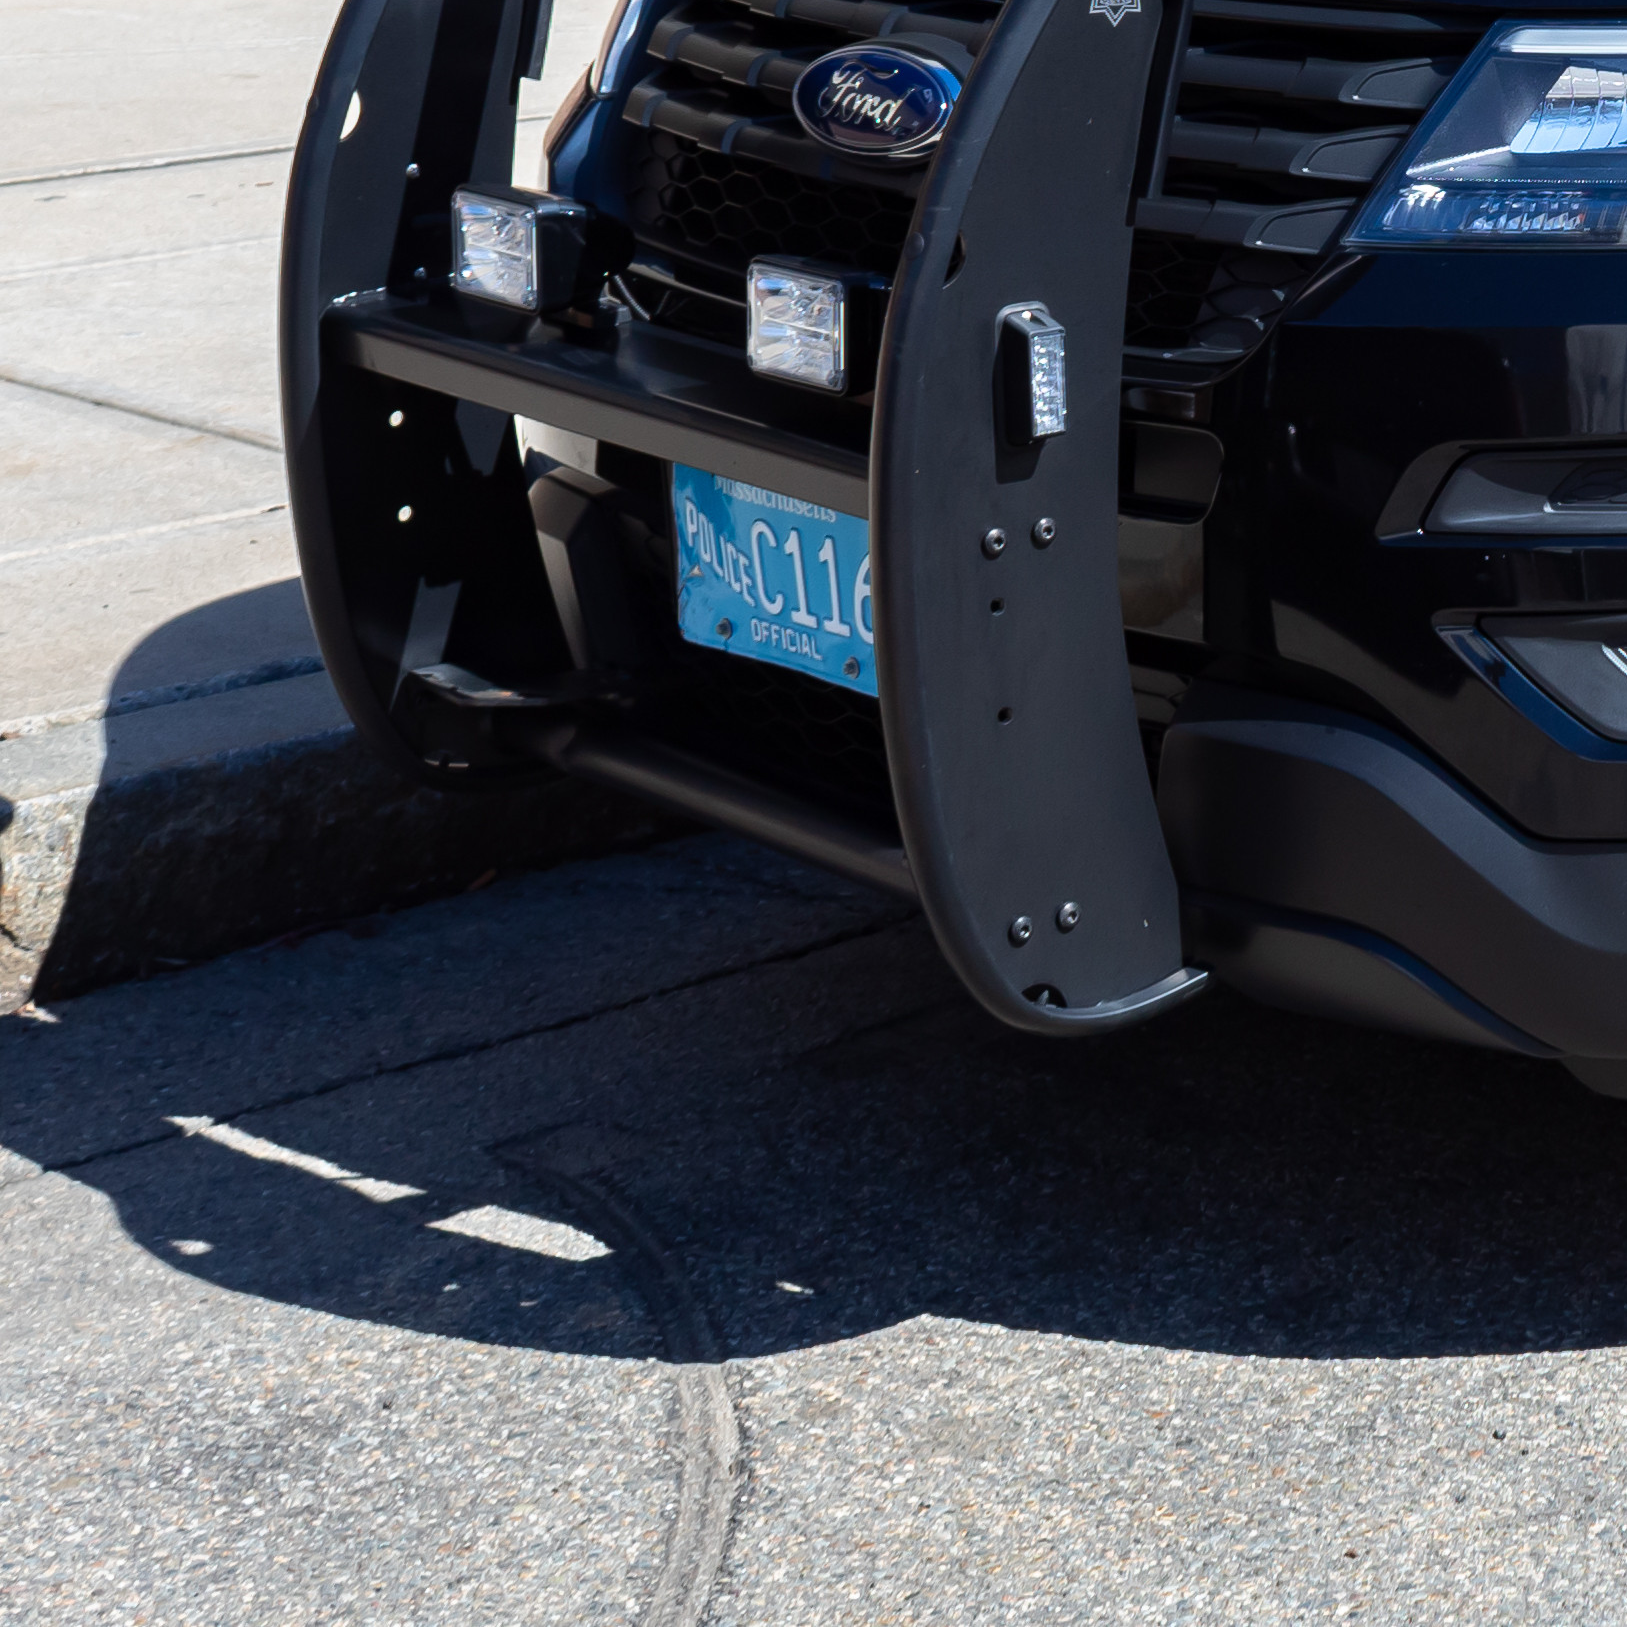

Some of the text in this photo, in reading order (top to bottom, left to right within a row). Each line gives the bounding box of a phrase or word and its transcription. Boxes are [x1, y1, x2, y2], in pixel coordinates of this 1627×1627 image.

[817, 57, 916, 136] Ford
[685, 496, 757, 608] POLICE
[750, 617, 823, 662] OFFICIAL
